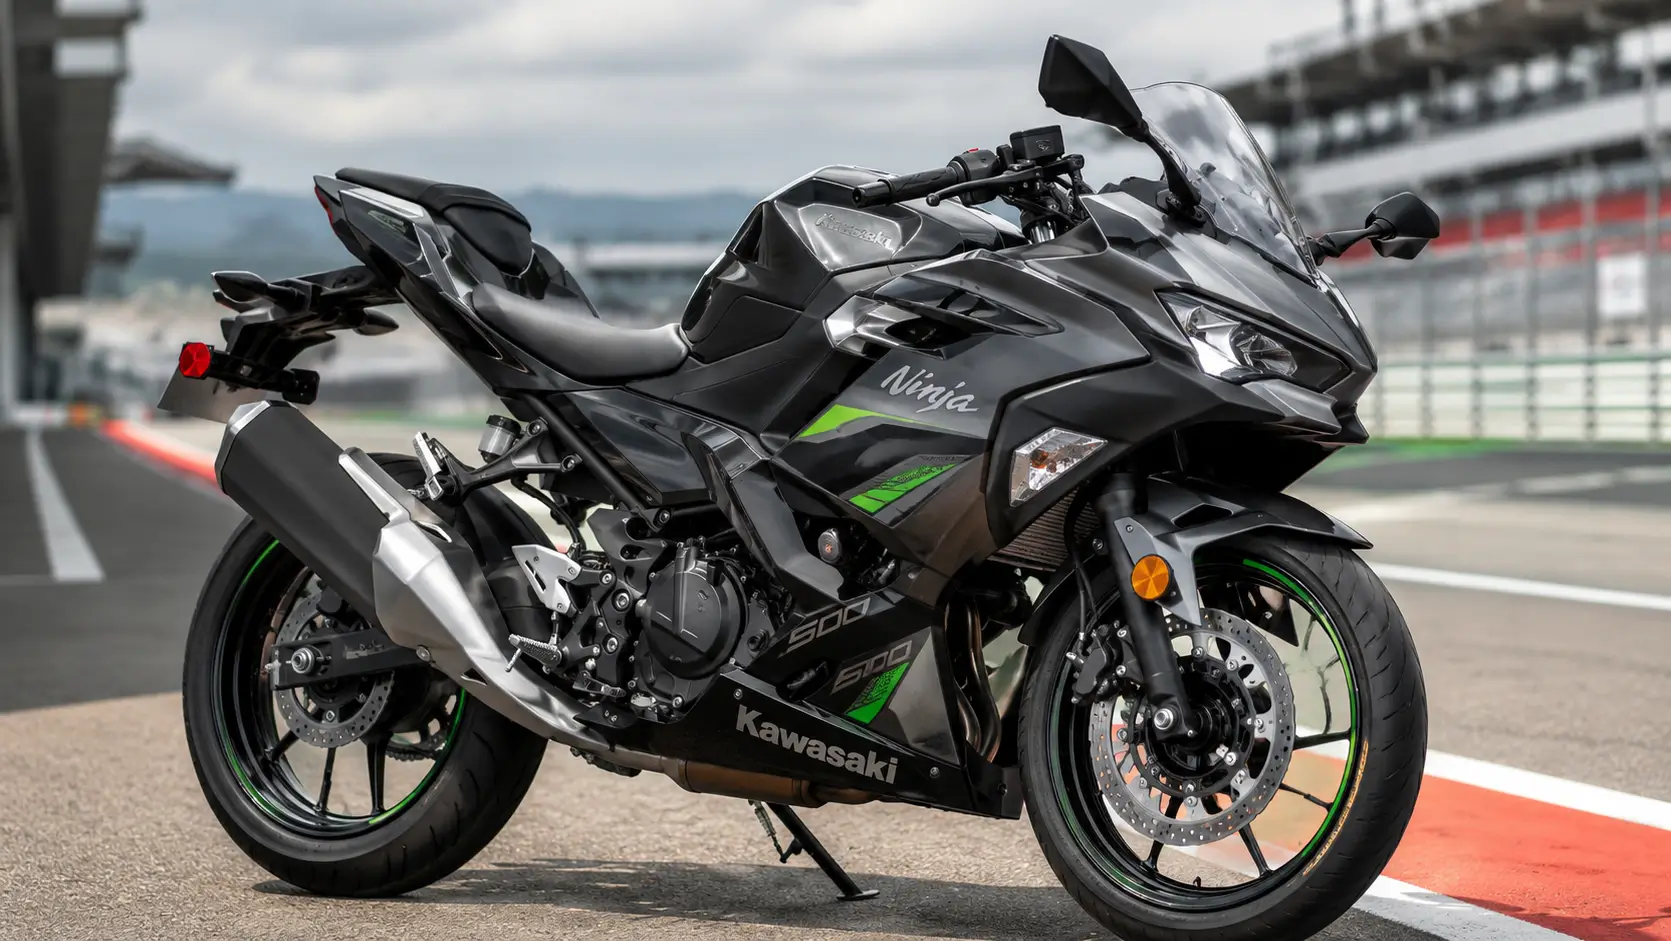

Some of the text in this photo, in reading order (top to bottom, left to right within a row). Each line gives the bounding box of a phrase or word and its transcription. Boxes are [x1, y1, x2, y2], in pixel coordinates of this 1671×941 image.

[880, 365, 979, 413] Ninja
[780, 597, 871, 656] 500
[735, 703, 899, 784] Kawasaki
